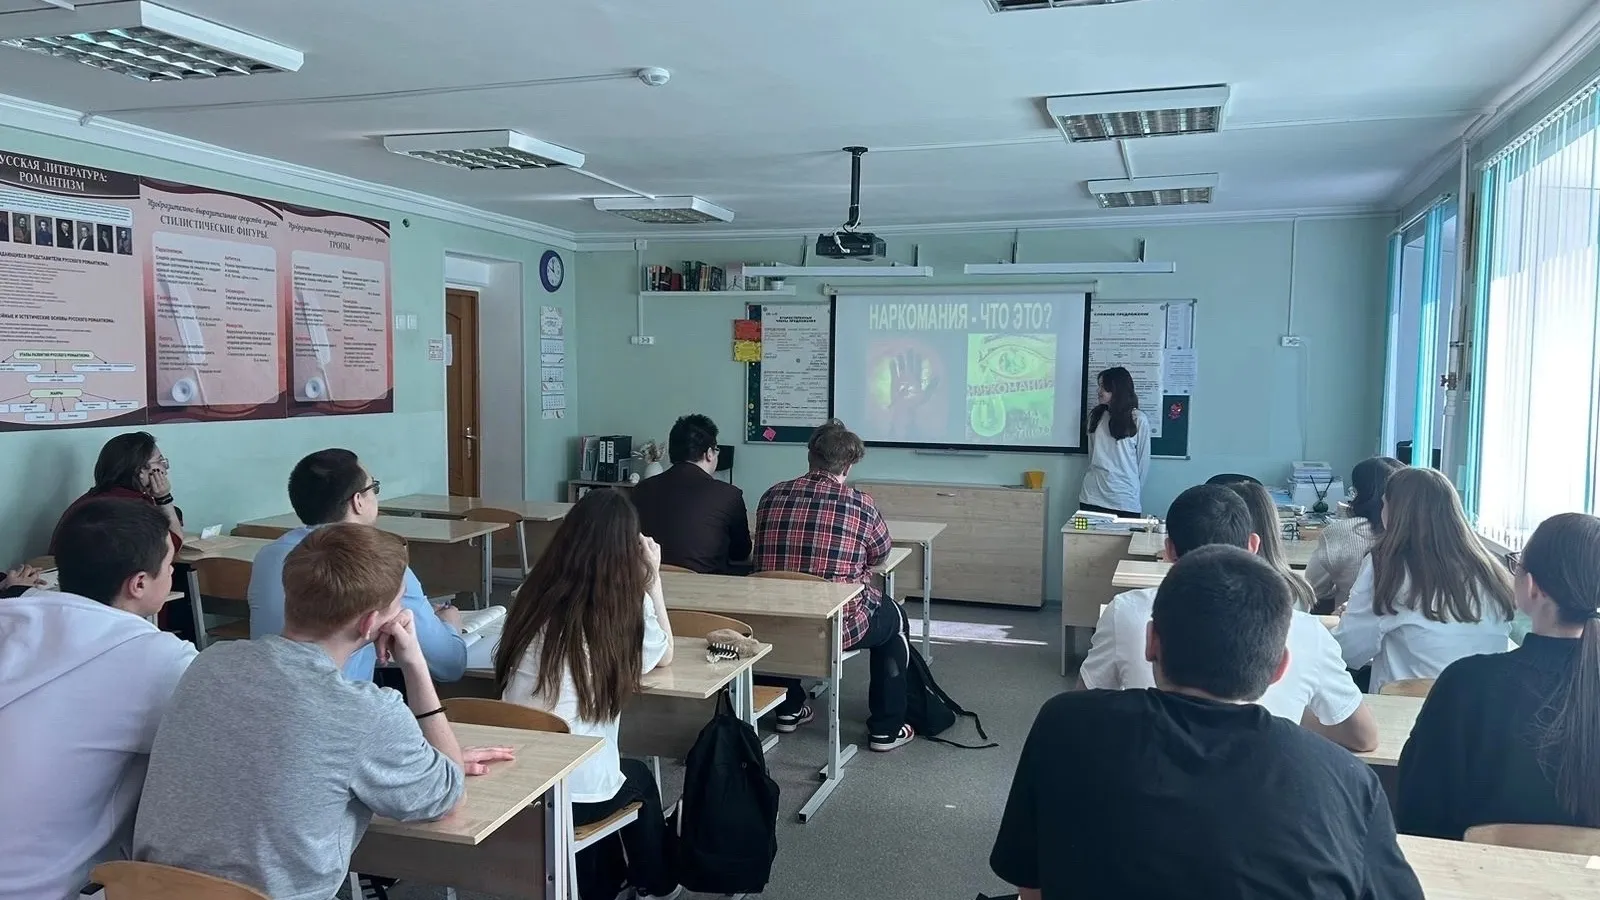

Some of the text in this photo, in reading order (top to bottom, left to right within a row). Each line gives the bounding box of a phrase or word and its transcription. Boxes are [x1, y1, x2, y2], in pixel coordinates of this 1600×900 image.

[19, 171, 85, 191] РОМАНТИЗМ
[42, 162, 108, 182] ЛИТЕРАТУРА:
[160, 215, 235, 234] СТИЛИСТИЧЕСКИЕ
[869, 303, 968, 330] НАРКОМАНИЯ
[980, 302, 1009, 330] ЧТО
[1012, 302, 1053, 330] ЭТО?
